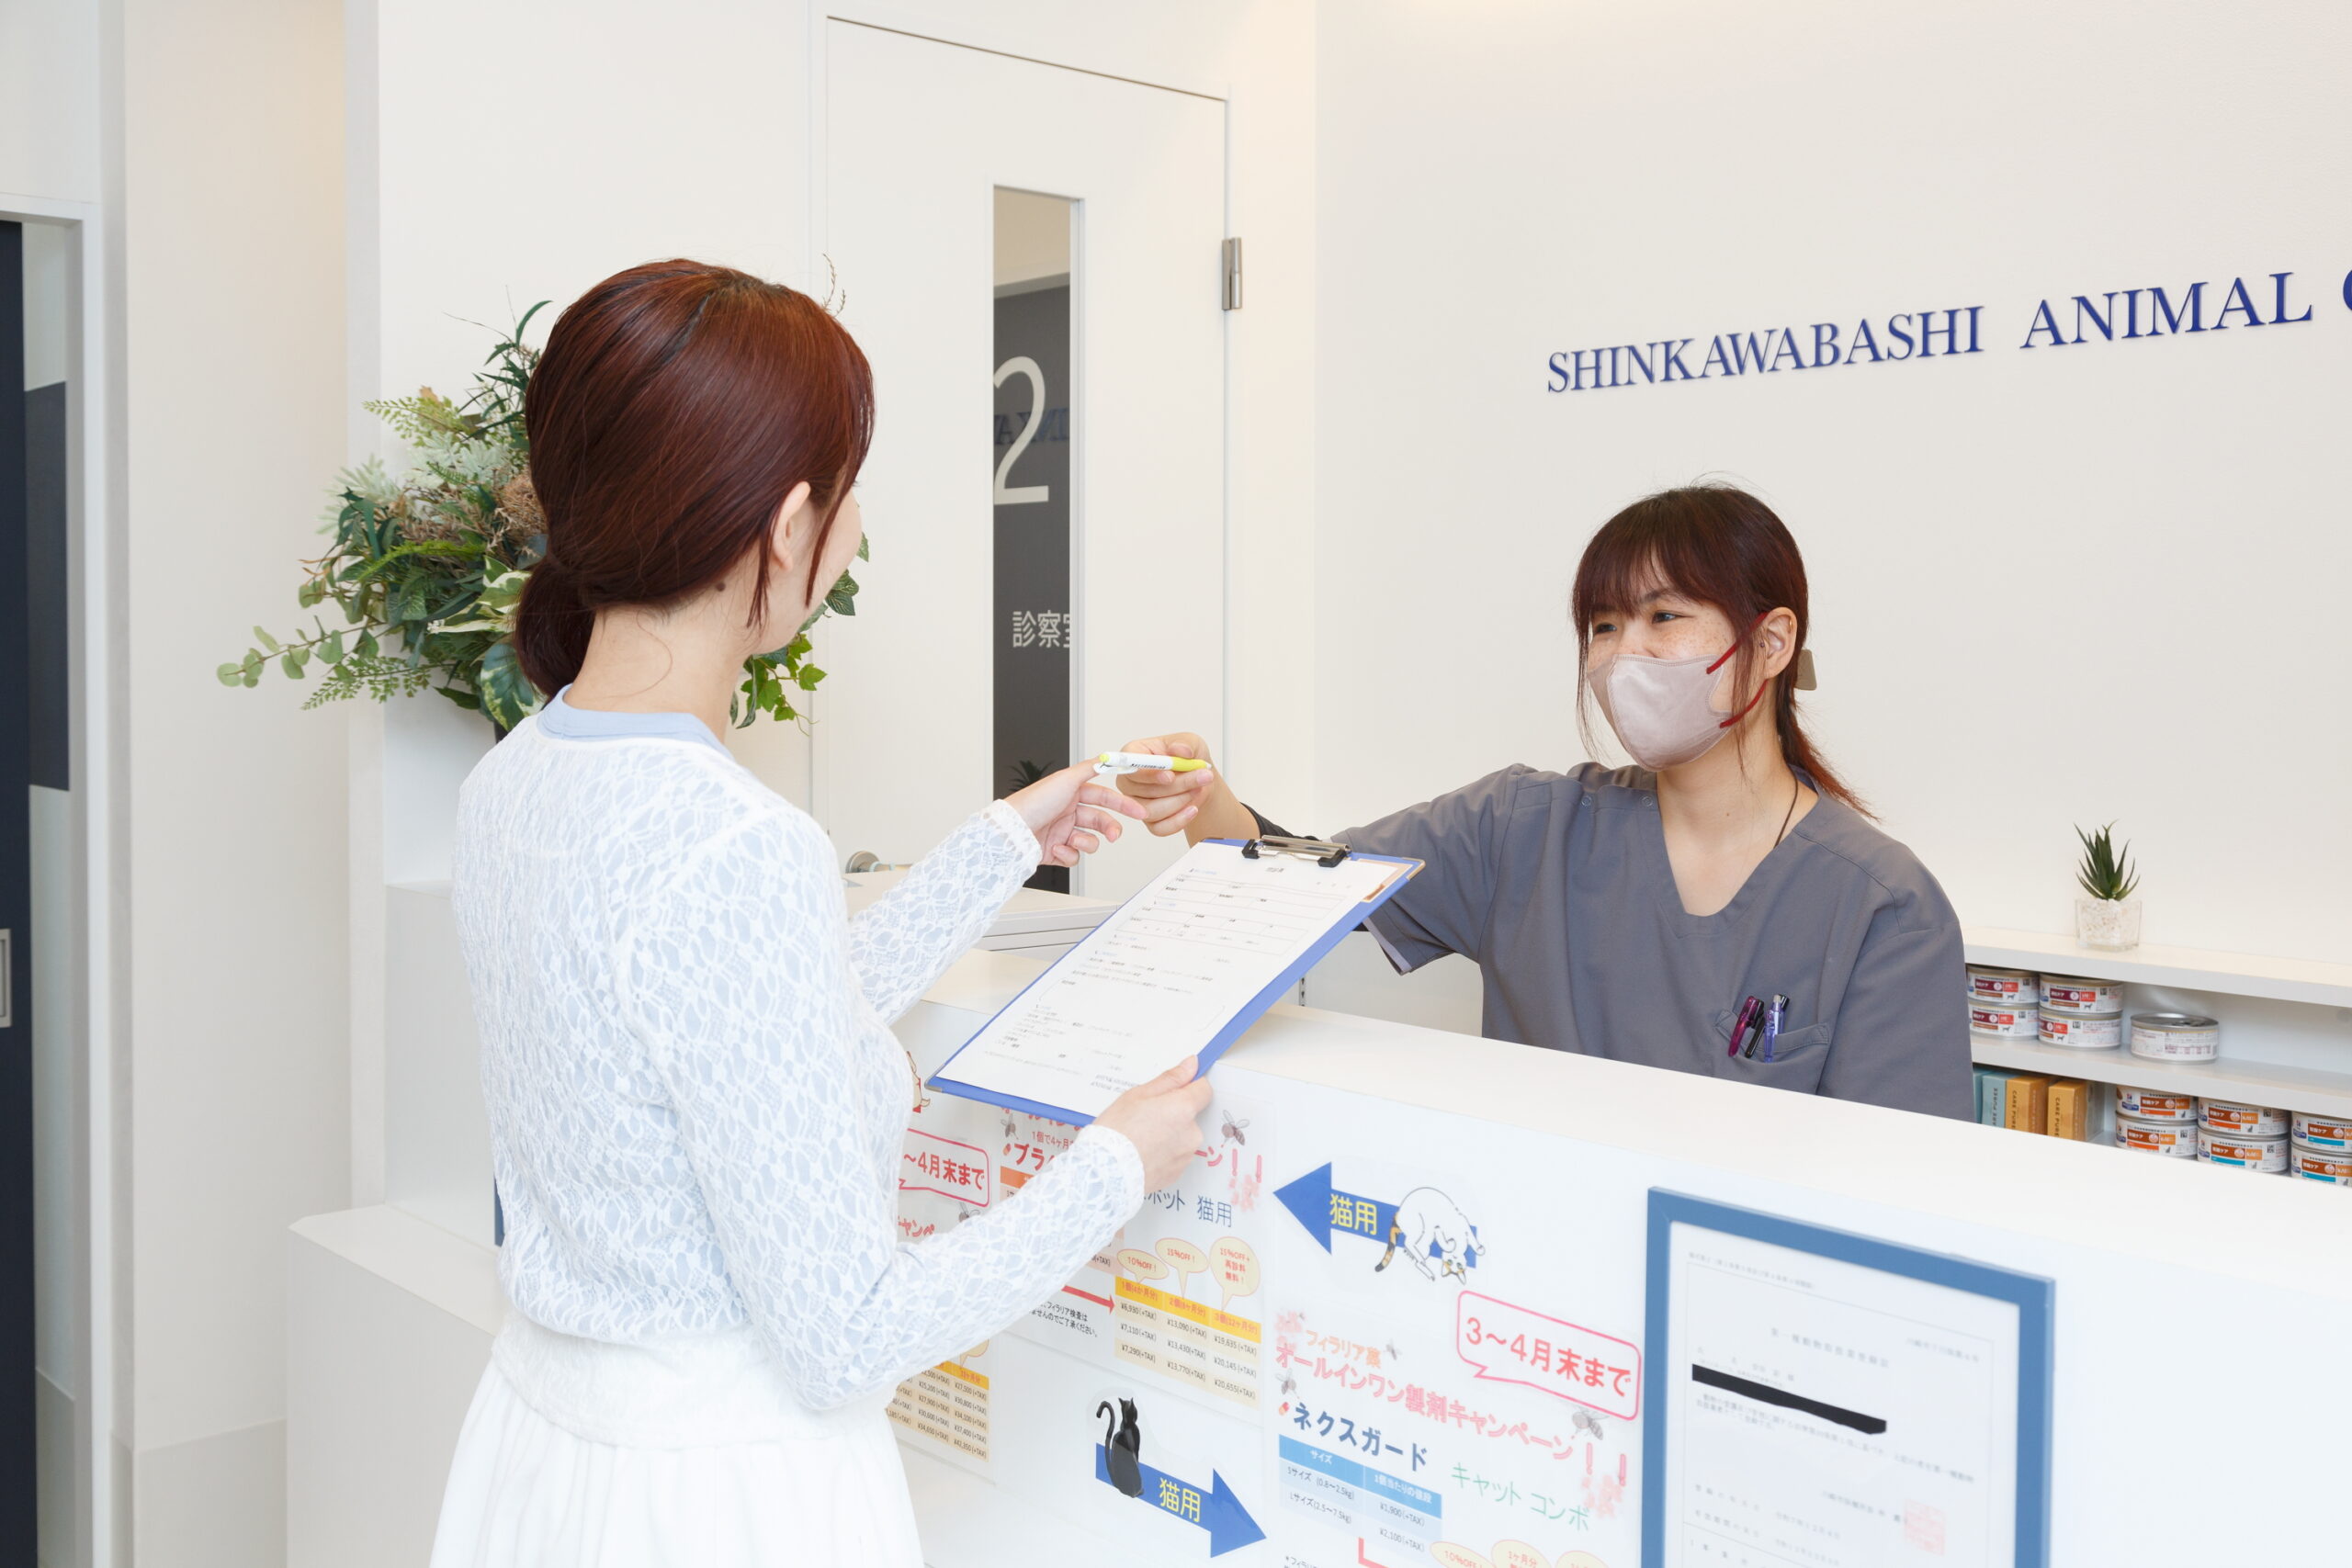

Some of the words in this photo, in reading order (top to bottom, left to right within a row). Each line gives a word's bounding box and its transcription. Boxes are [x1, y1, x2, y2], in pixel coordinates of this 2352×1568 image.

[1548, 306, 1984, 393] SHINKAWABASHI
[2019, 271, 2314, 349] ANIMAL
[993, 355, 1049, 504] 2
[1012, 610, 1069, 649] 診察
[1014, 1143, 1055, 1170] ブラ
[1032, 1131, 1073, 1150] 1個で4ヶ月
[1196, 1194, 1232, 1228] 猫用
[1329, 1192, 1377, 1236] 猫用
[1465, 1316, 1632, 1398] 3～4月末まで
[1293, 1401, 1428, 1472] ネクスガード
[1308, 1449, 1333, 1465] サイズ
[1158, 1476, 1203, 1524] 猫用
[1451, 1462, 1522, 1506] キャット
[1530, 1493, 1590, 1531] コンボ
